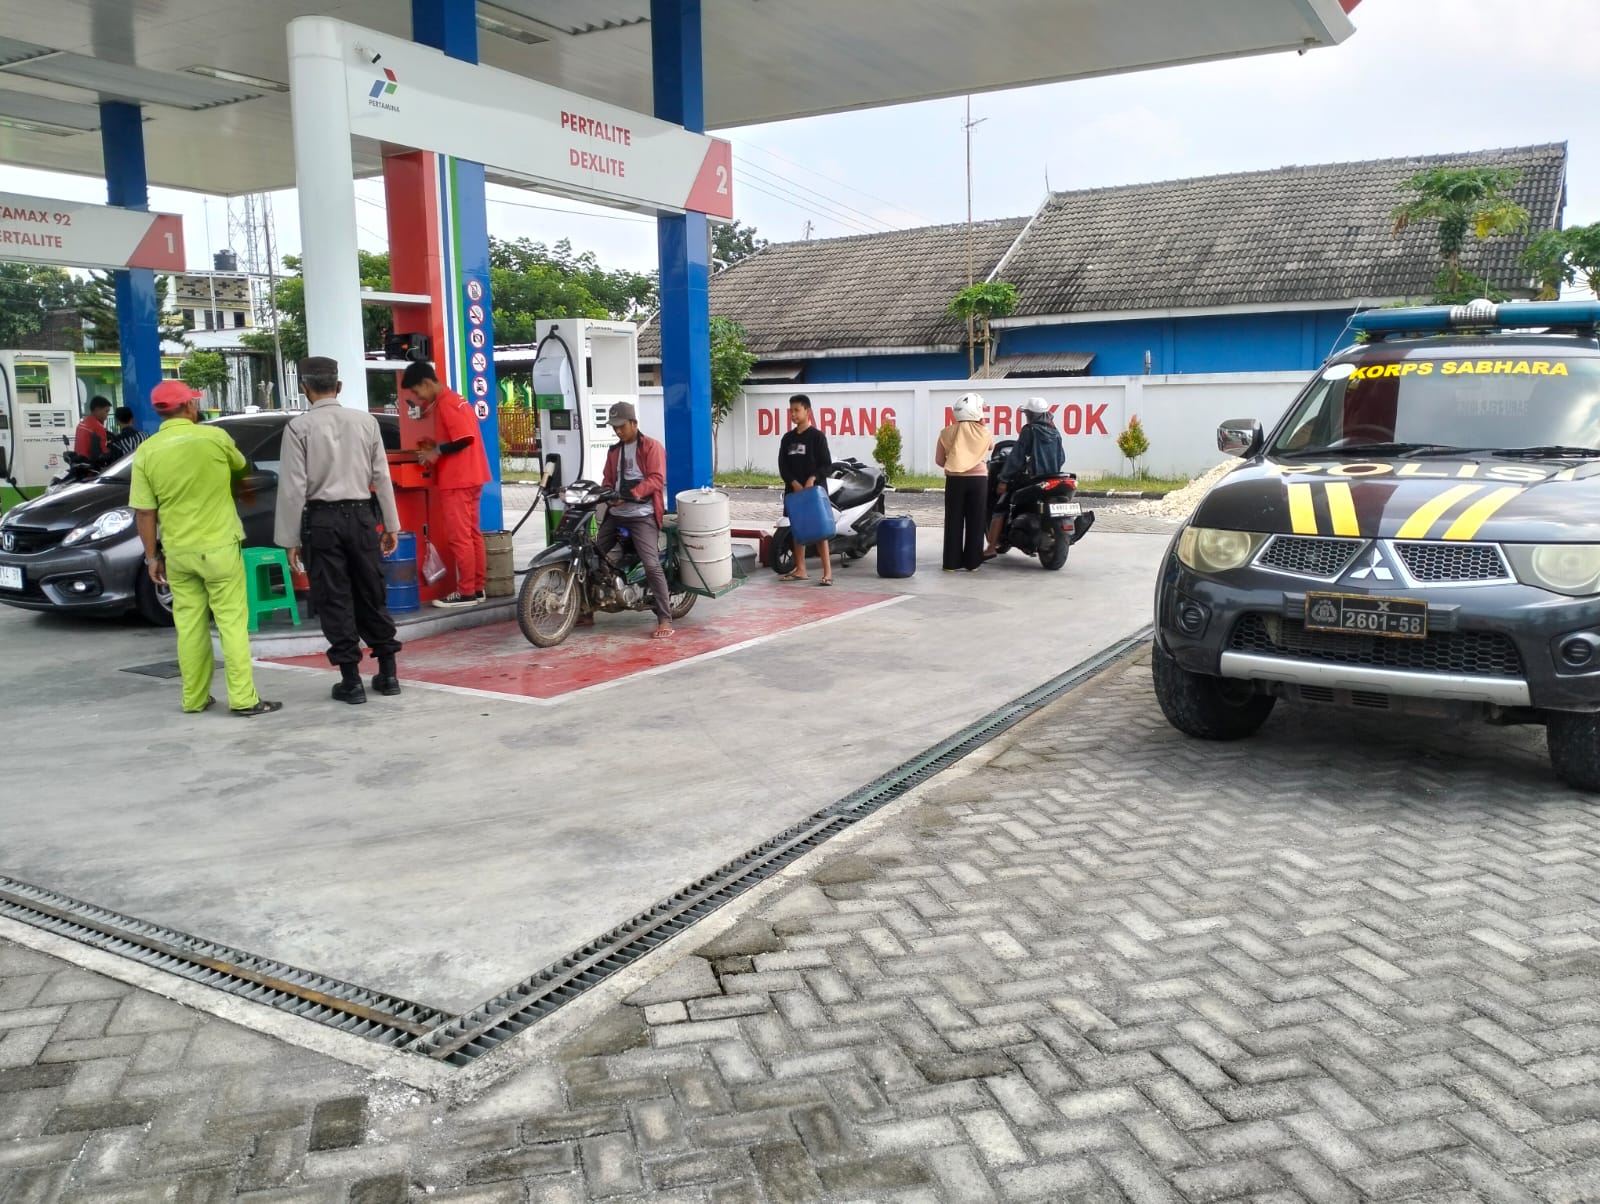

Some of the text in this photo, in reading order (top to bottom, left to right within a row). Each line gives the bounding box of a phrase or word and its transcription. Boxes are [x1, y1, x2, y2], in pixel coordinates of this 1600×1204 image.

[560, 111, 631, 146] PERTALITE
[569, 149, 625, 177] DEXLITE
[715, 166, 727, 194] 2
[53, 212, 71, 226] 92
[164, 232, 174, 254] 1
[1348, 361, 1568, 380] KORPS SABHARA
[945, 403, 1108, 436] ROOK
[1264, 462, 1578, 482] POLISI
[1377, 601, 1391, 612] X
[1345, 612, 1420, 633] 2601-58
